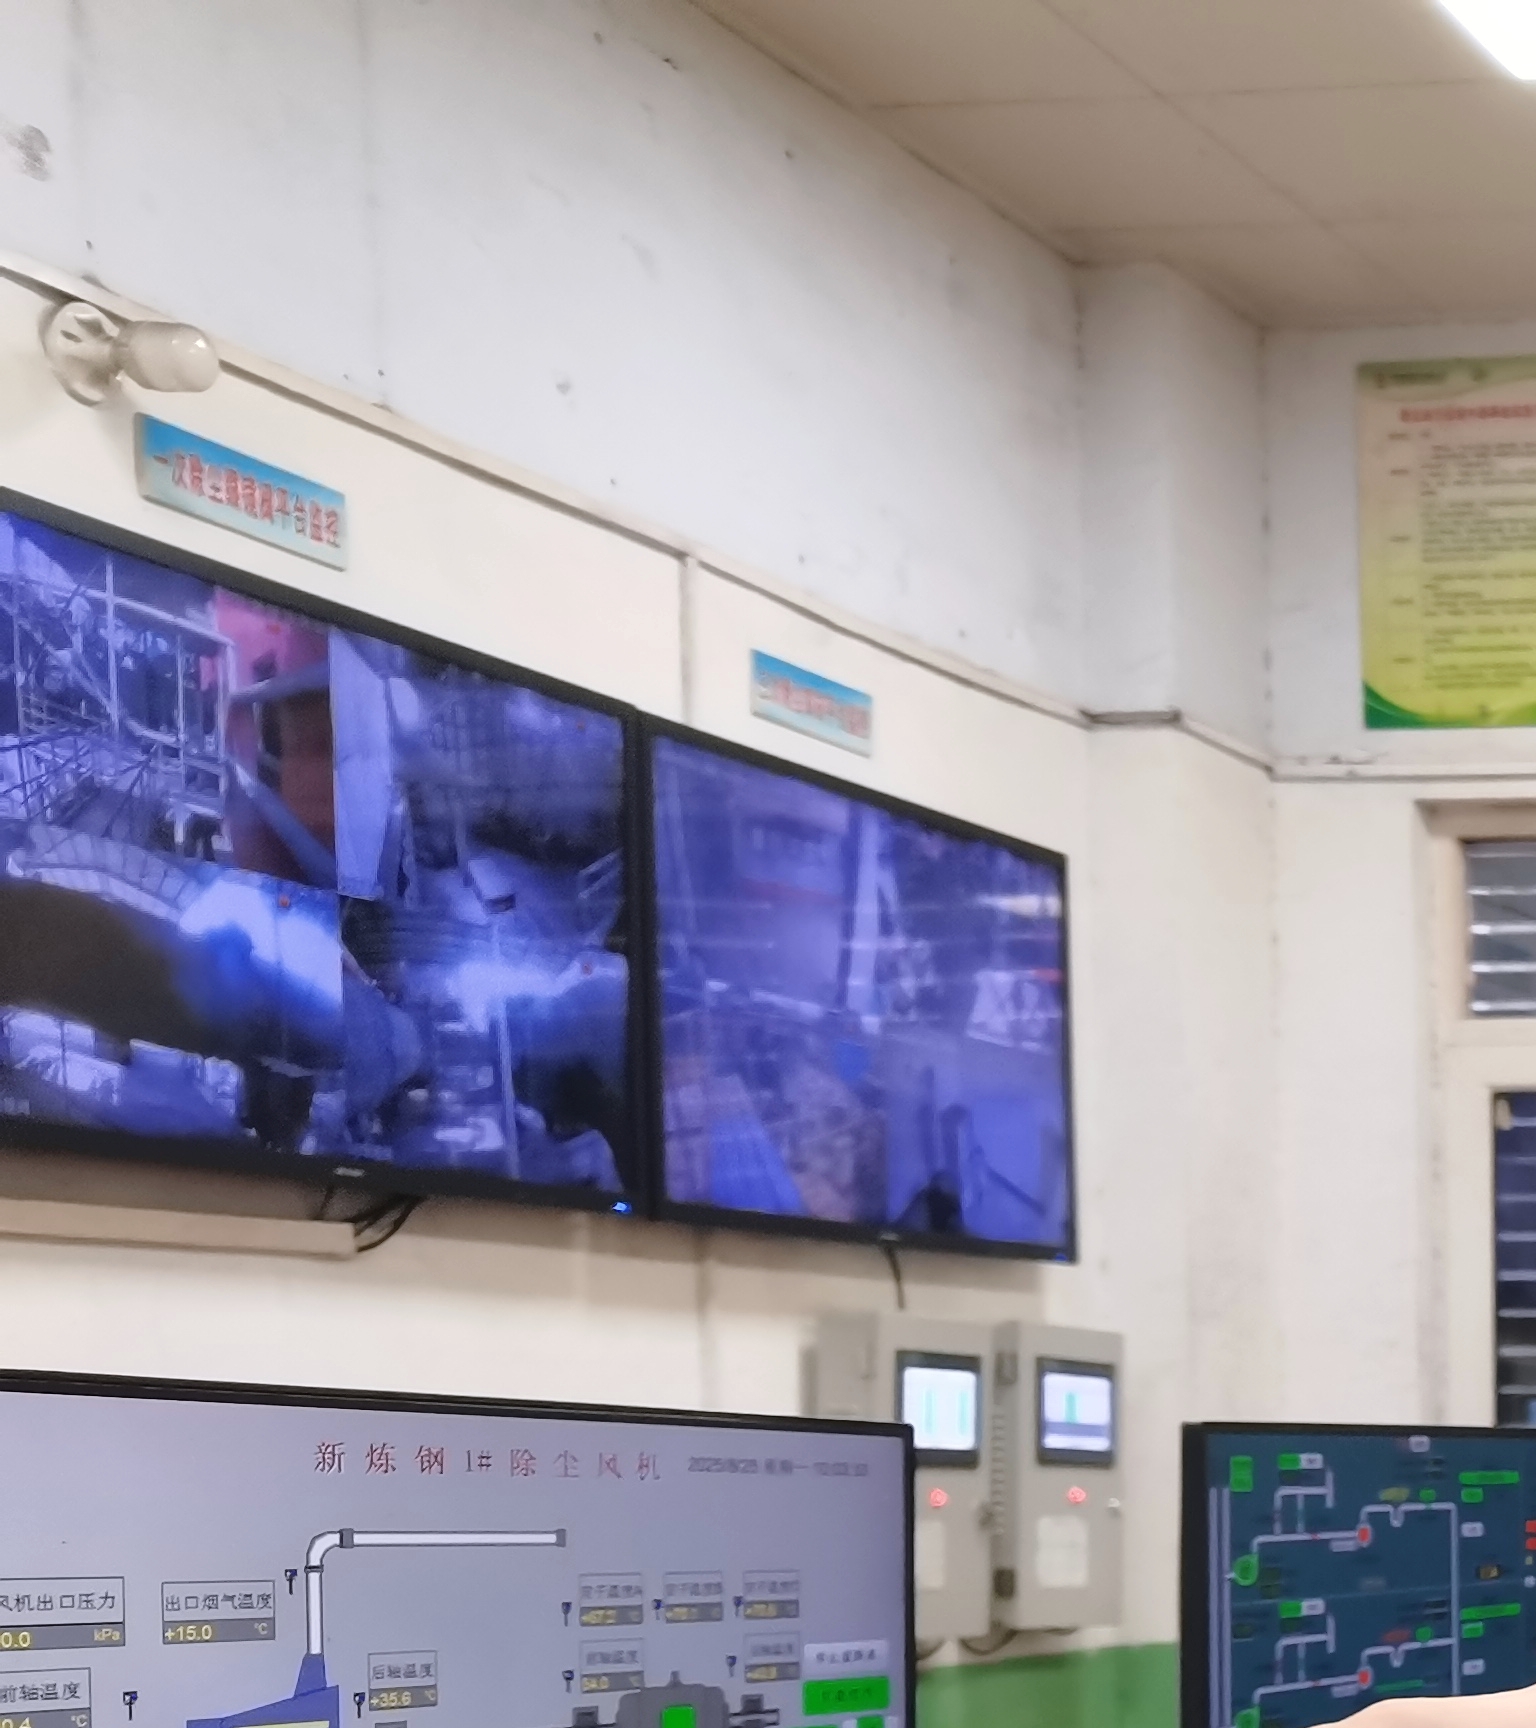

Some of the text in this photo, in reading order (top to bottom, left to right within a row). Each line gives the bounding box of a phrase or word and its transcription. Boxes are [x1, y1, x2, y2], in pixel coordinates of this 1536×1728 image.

[165, 1593, 272, 1612] 出口烟气温度
[93, 1628, 121, 1641] kPa
[165, 1625, 213, 1642] +15.0
